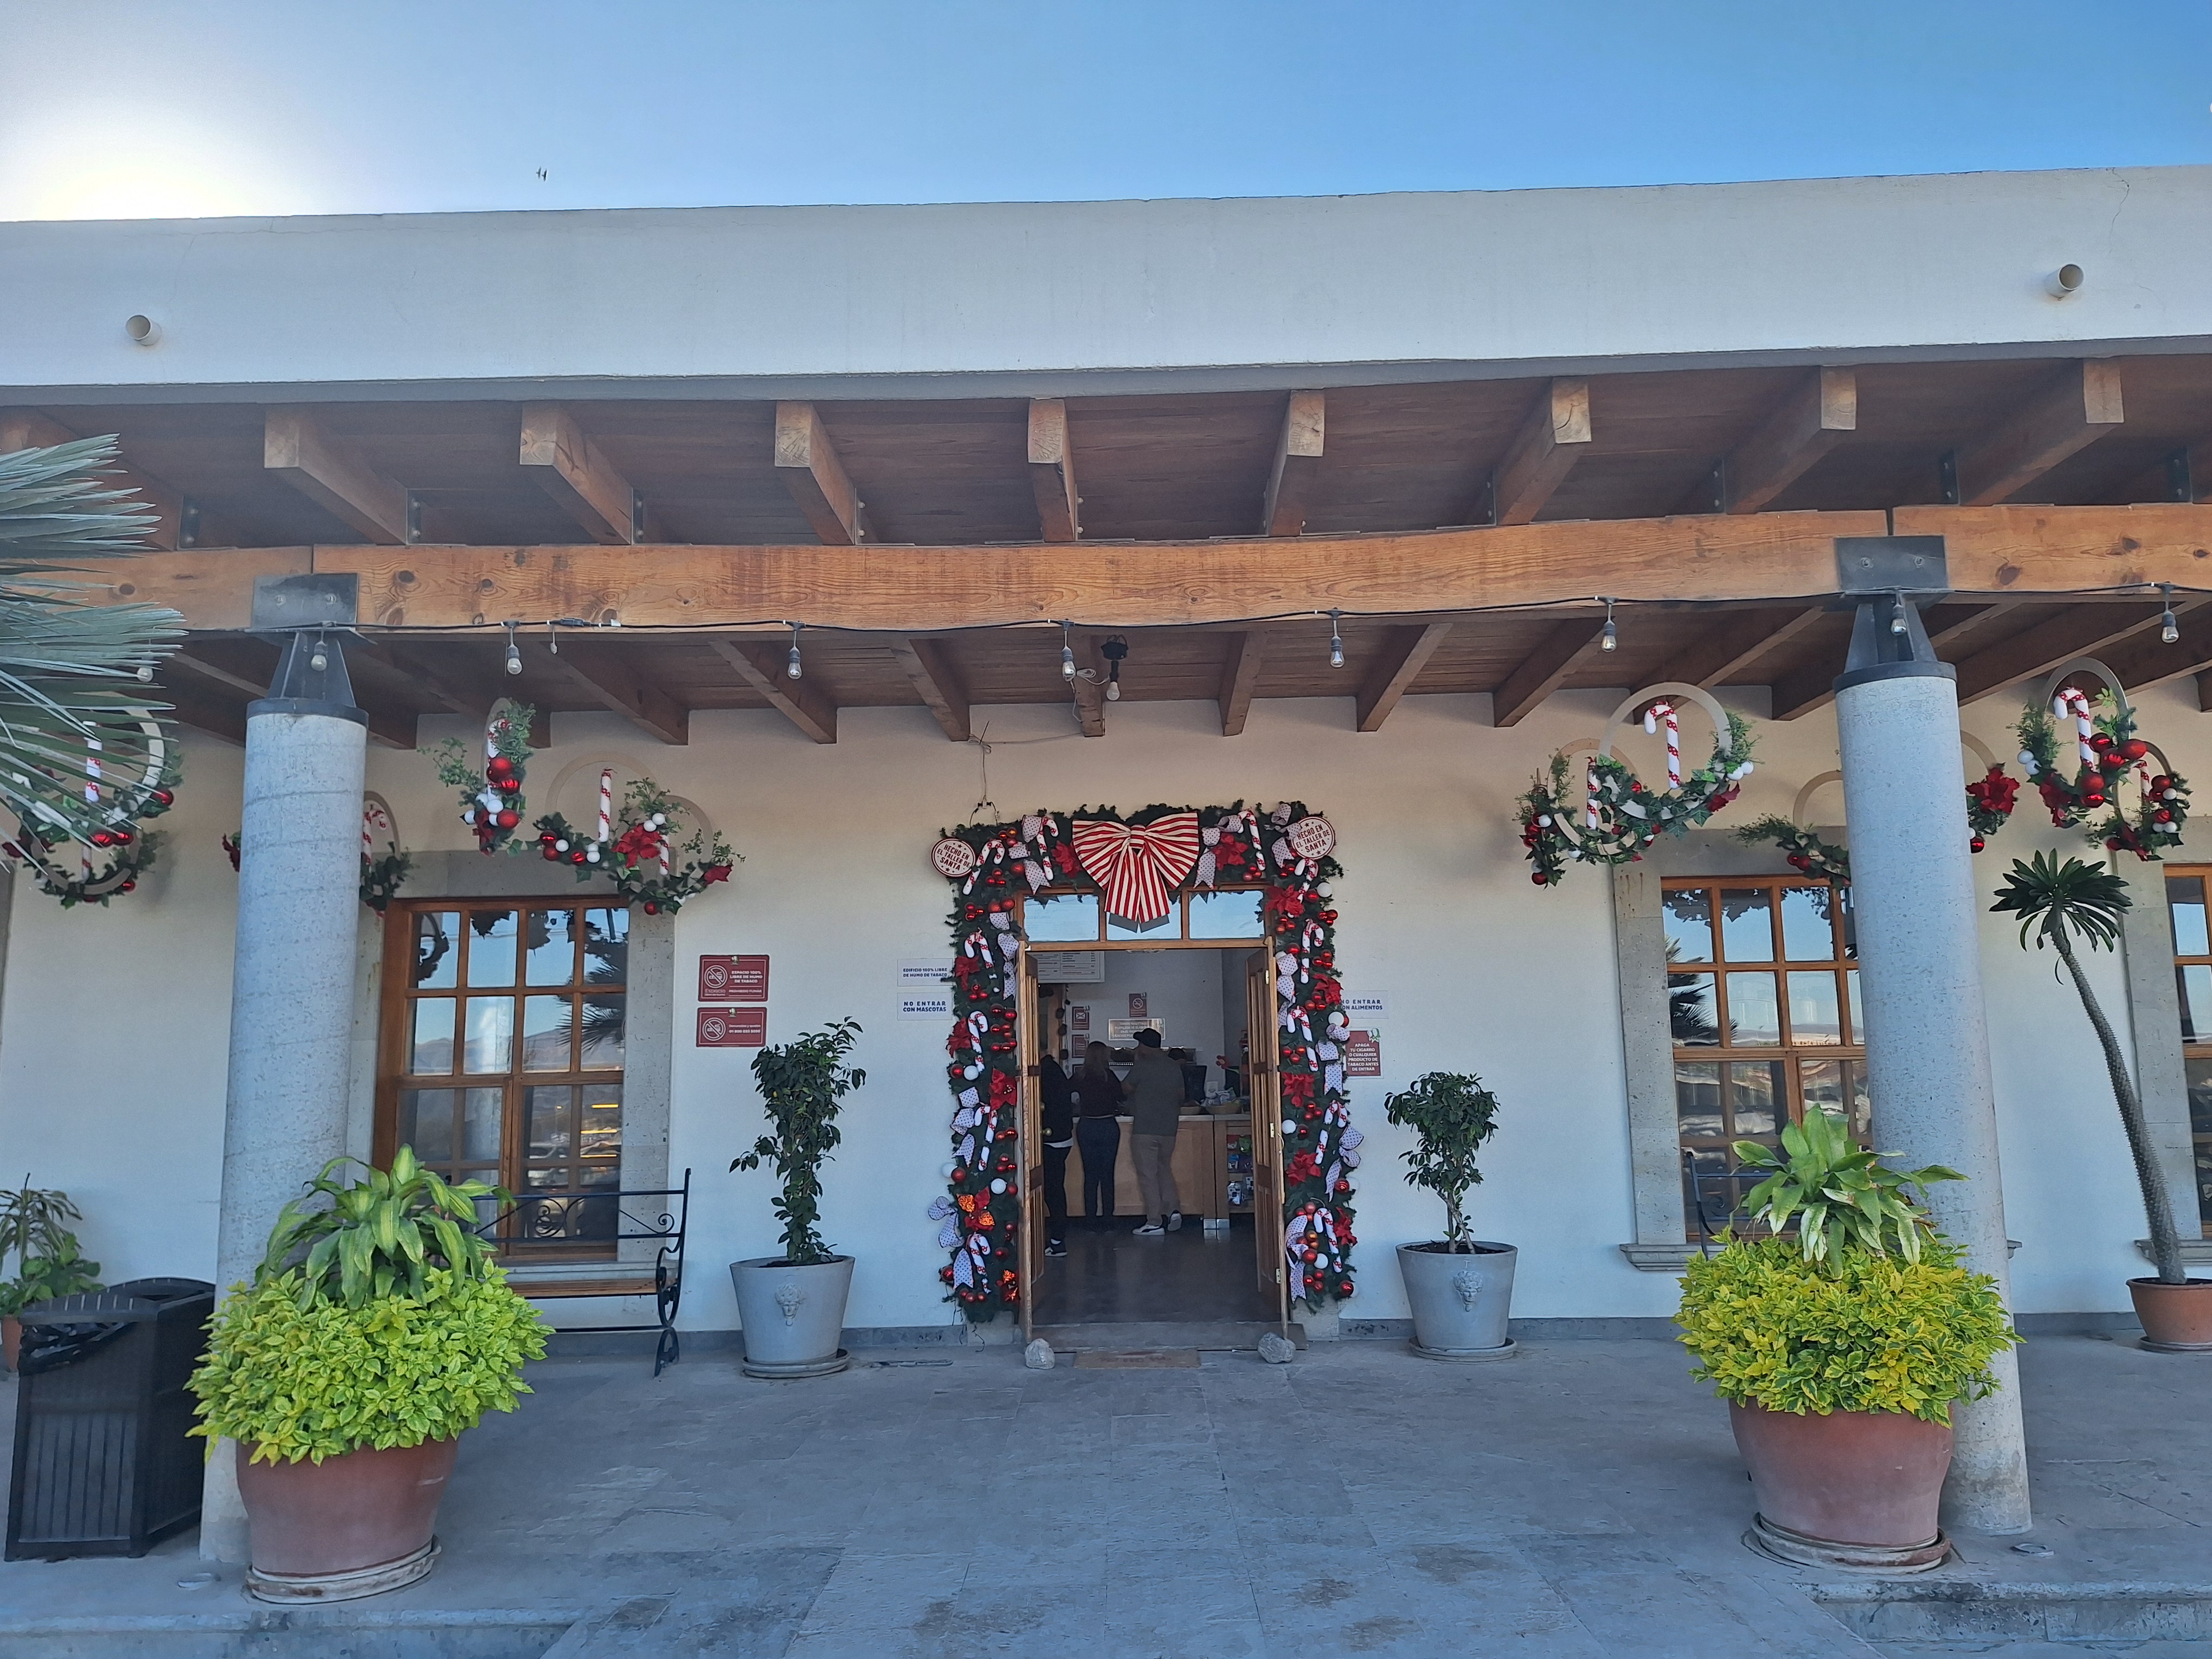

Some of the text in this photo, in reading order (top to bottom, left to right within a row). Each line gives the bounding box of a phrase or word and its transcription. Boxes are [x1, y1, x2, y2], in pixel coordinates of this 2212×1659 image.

[1297, 824, 1323, 840] HECHO EN
[1303, 833, 1322, 845] TALLER
[944, 844, 961, 856] HECHO
[1305, 839, 1327, 852] SANTA
[940, 857, 960, 870] SANTA
[944, 852, 963, 864] TALLER
